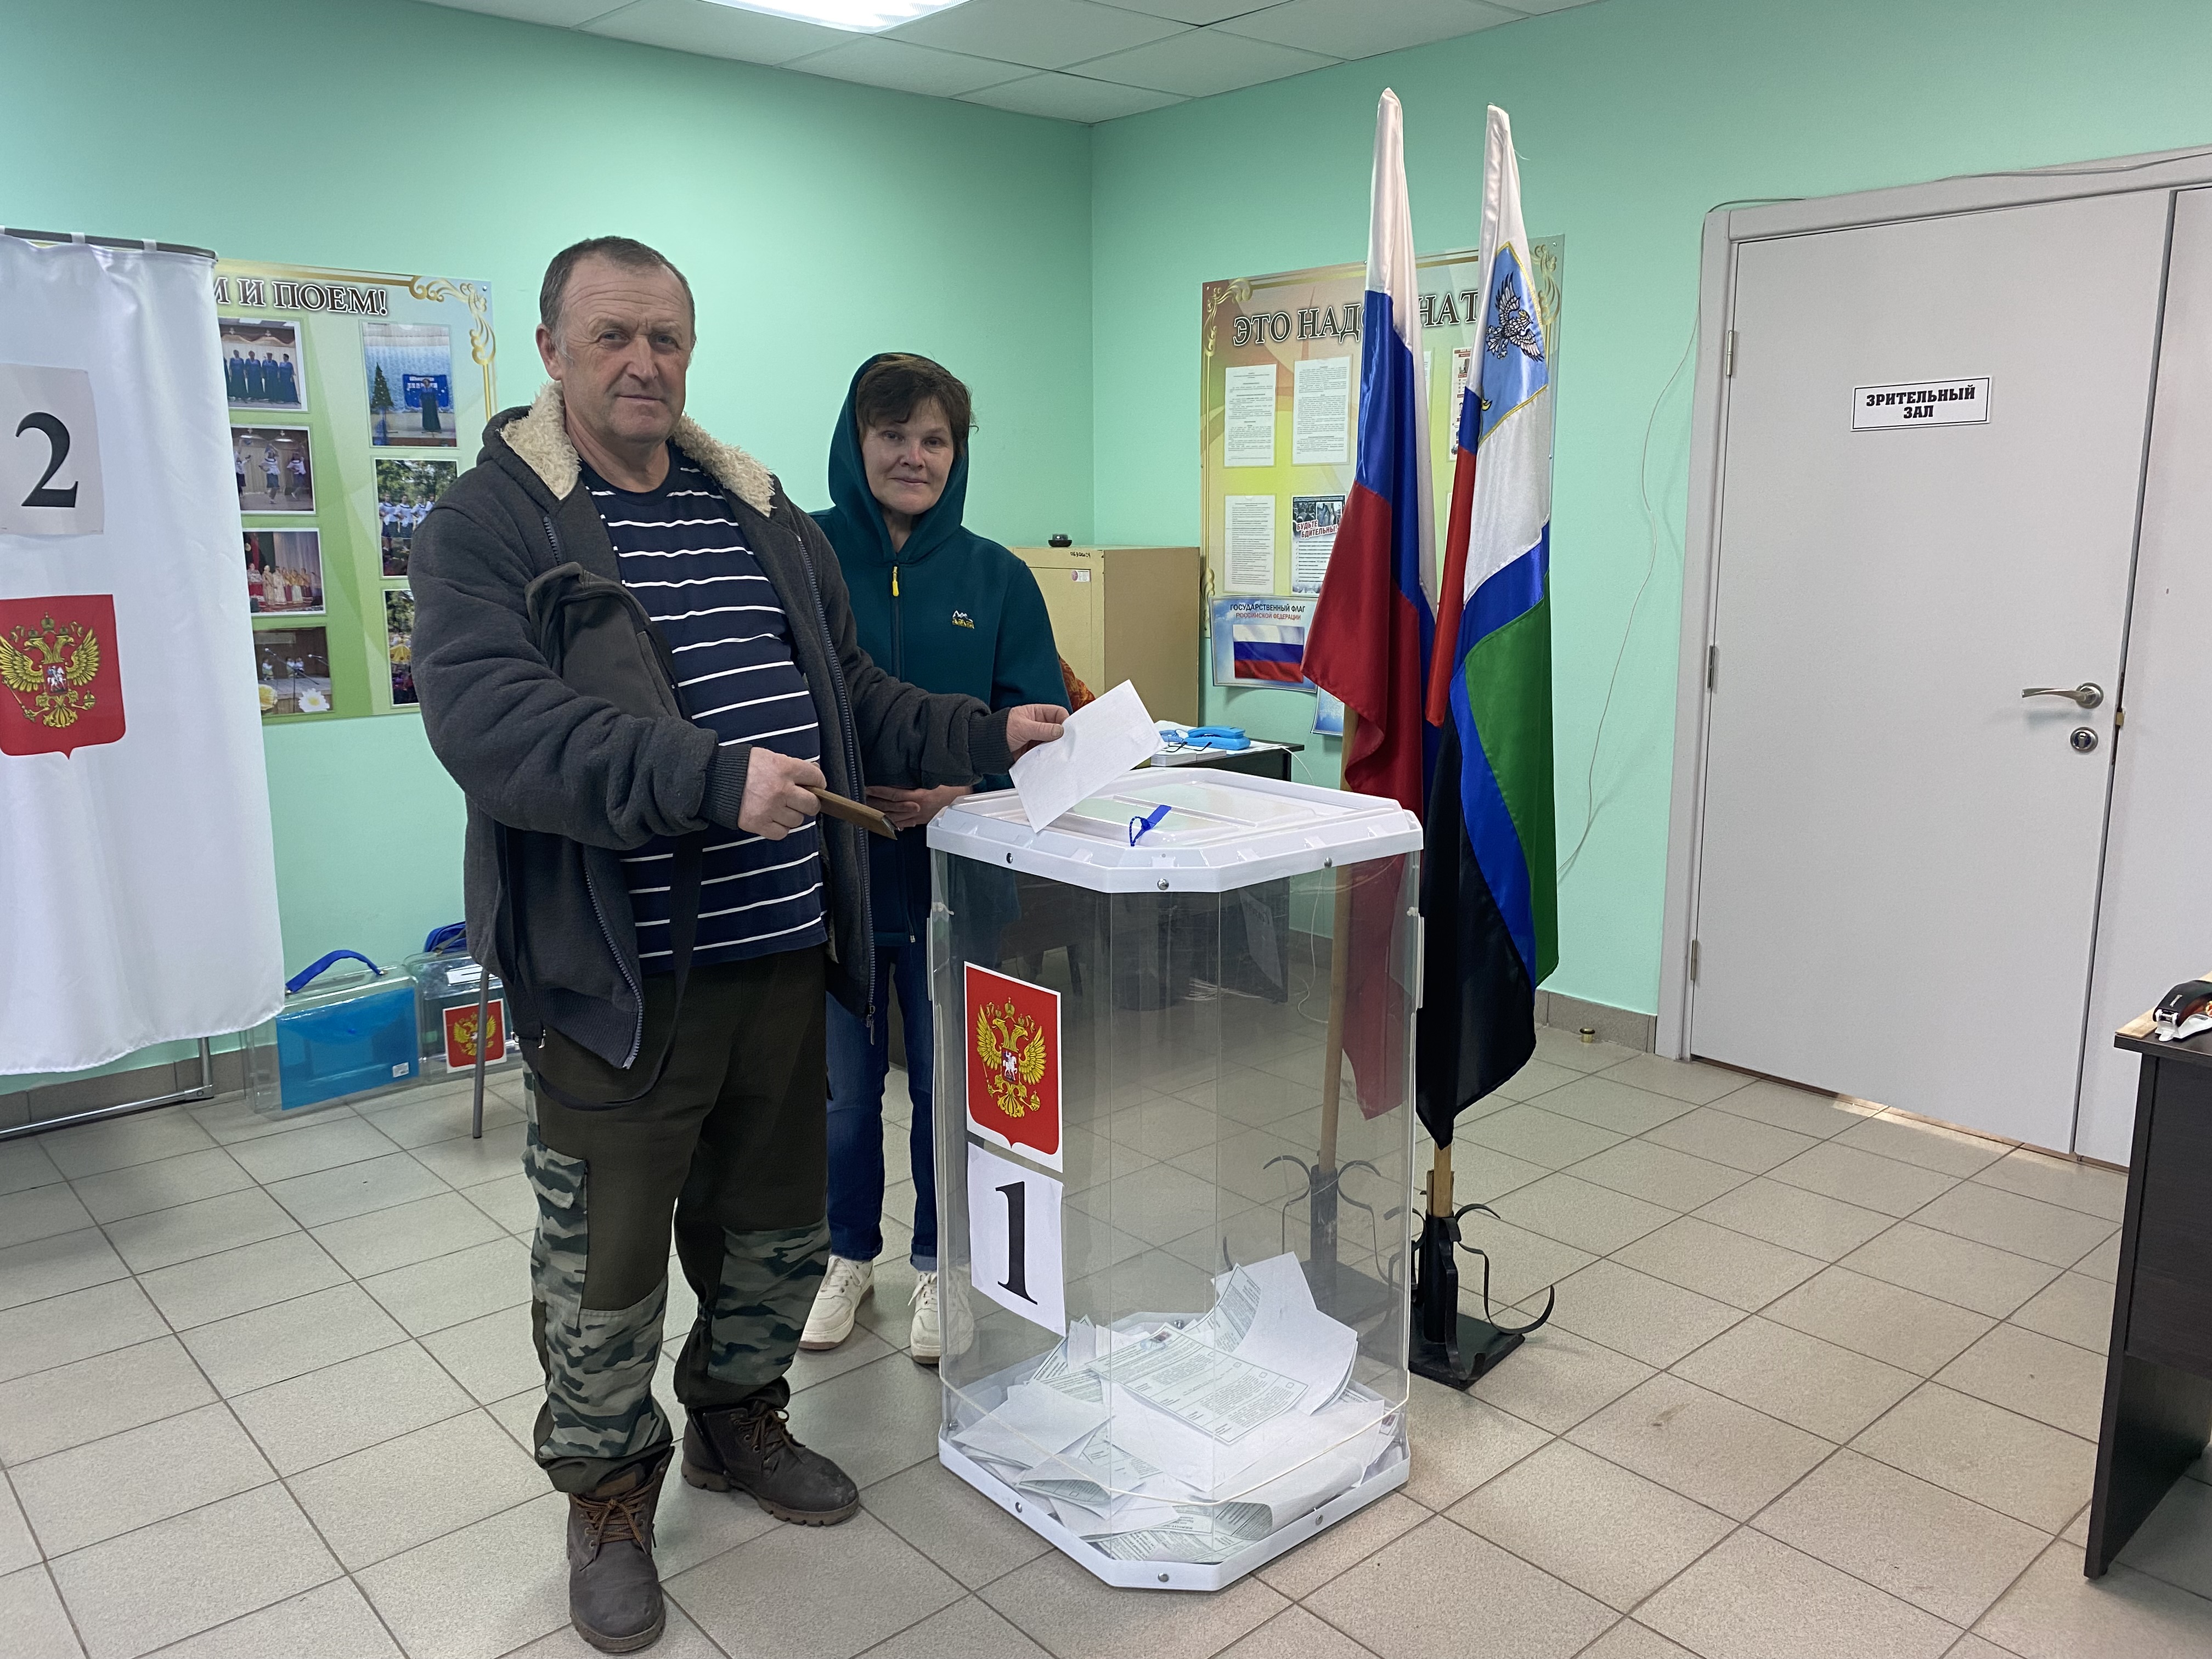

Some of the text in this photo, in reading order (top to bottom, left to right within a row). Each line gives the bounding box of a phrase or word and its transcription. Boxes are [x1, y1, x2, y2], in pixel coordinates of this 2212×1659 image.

[237, 278, 267, 307] И
[272, 281, 387, 315] ПОЕМ!
[1233, 290, 1479, 347] ЭТО НАД НАТ
[1866, 385, 1975, 406] ЗРИТЕЛЬНЫЙ
[1903, 405, 1934, 419] ЗАЛ
[15, 411, 78, 508] 2
[1297, 521, 1318, 531] БУДЬТЕ
[1301, 526, 1338, 538] БДИТЕЛЬНЫ!
[1230, 603, 1290, 612] ГОСУДАРСТВЕННЫЙ
[995, 1181, 1039, 1306] 1
